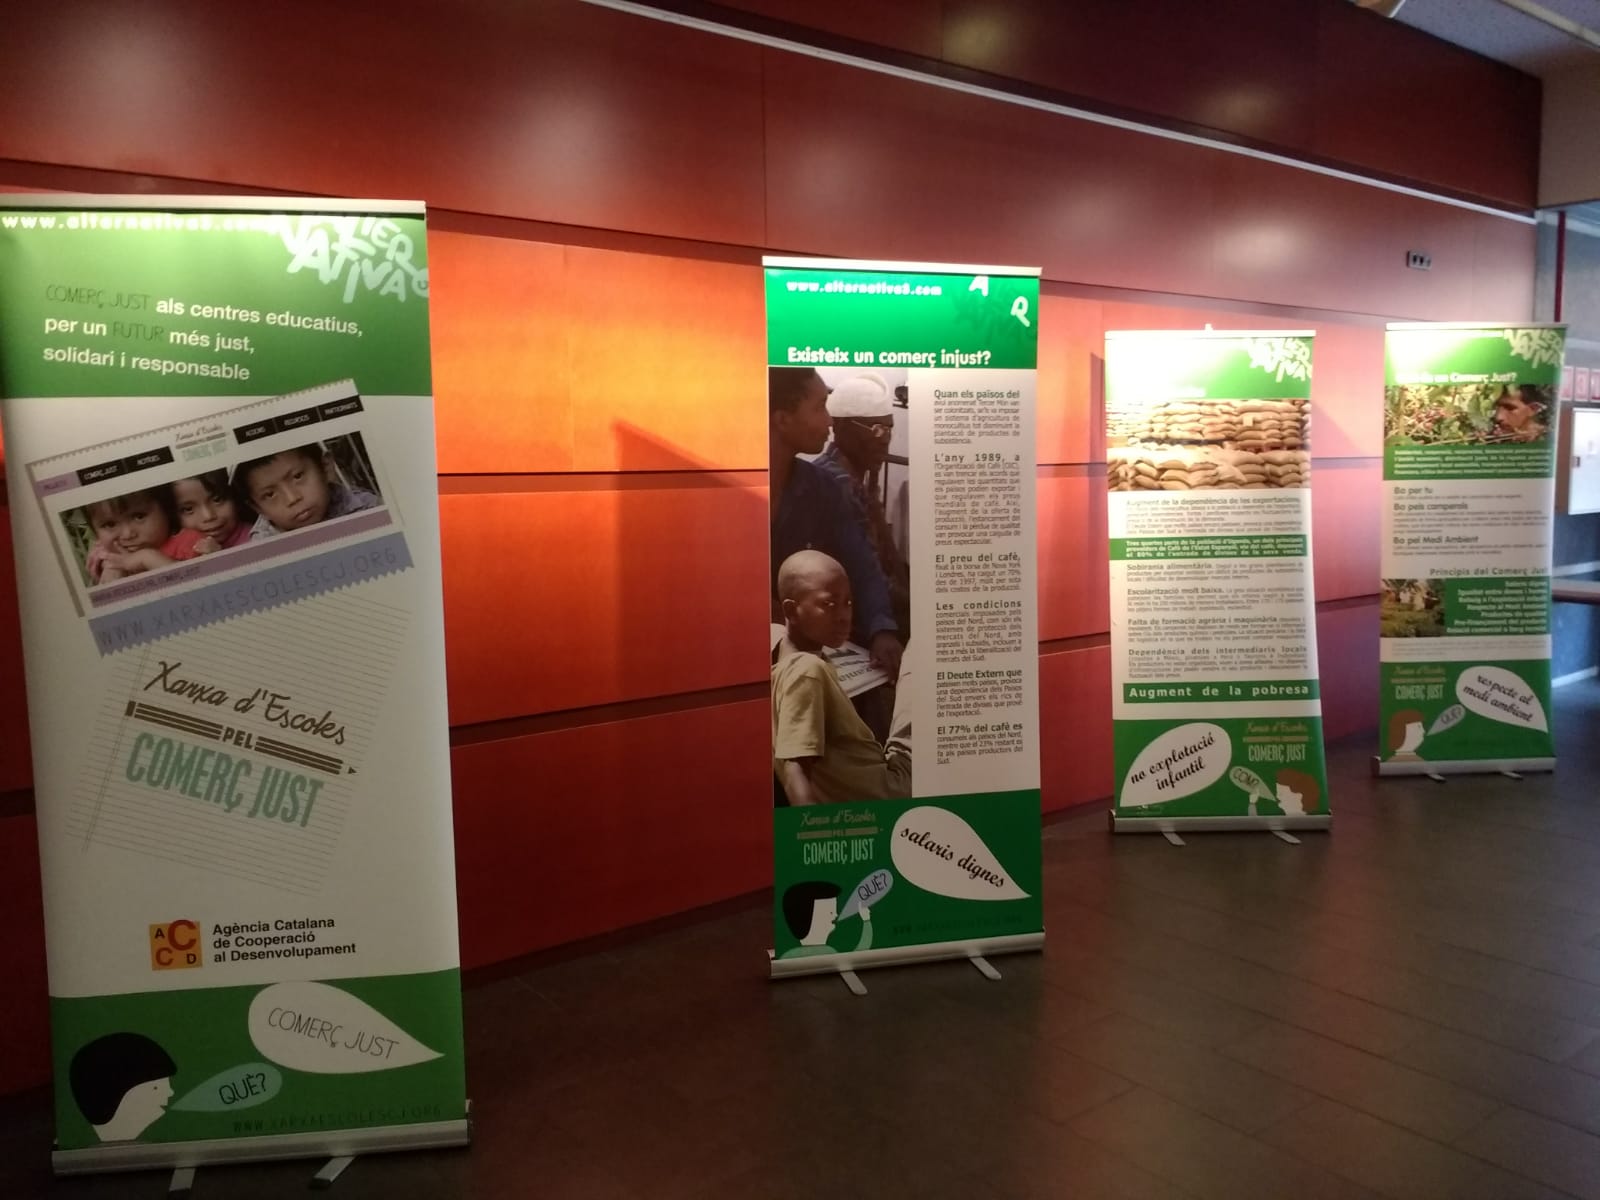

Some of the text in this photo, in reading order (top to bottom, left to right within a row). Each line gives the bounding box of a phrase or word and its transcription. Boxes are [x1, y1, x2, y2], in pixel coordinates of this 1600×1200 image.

[46, 284, 363, 337] COMERÇ JUST als centres educatius,
[44, 317, 254, 354] per un FUTUR més just,
[43, 346, 250, 381] solidari i responsable
[787, 346, 991, 367] Existeix un comerç injust?
[934, 389, 1020, 401] Quan els països del
[934, 453, 1020, 463] L'any 1989, a
[935, 552, 1021, 564] El preu del cafè,
[936, 600, 1022, 611] Les condicions
[936, 669, 1022, 680] El Deute Extern que
[144, 660, 346, 746] Xarxa d'Escoles
[1128, 684, 1309, 700] Augment de la pobresa
[1463, 685, 1533, 722] medi ambient
[1477, 674, 1534, 706] respecte al
[222, 727, 255, 750] PEL
[937, 722, 1023, 735] El 77% del cafè es
[1130, 731, 1216, 785] no explotació
[1248, 743, 1306, 763] COMERÇ JUST
[126, 731, 324, 828] COMERÇ JUST
[1155, 756, 1206, 791] infantil
[803, 838, 874, 865] COMERÇ JUST
[900, 825, 1005, 889] salaris dignes
[857, 874, 888, 901] QUÈ?
[212, 917, 335, 938] Agència Catalana
[213, 931, 316, 950] de Cooperació
[213, 943, 357, 963] al Desenvolupament
[268, 1007, 400, 1060] COMERÇ JUST
[218, 1071, 268, 1106] QUÈ?
